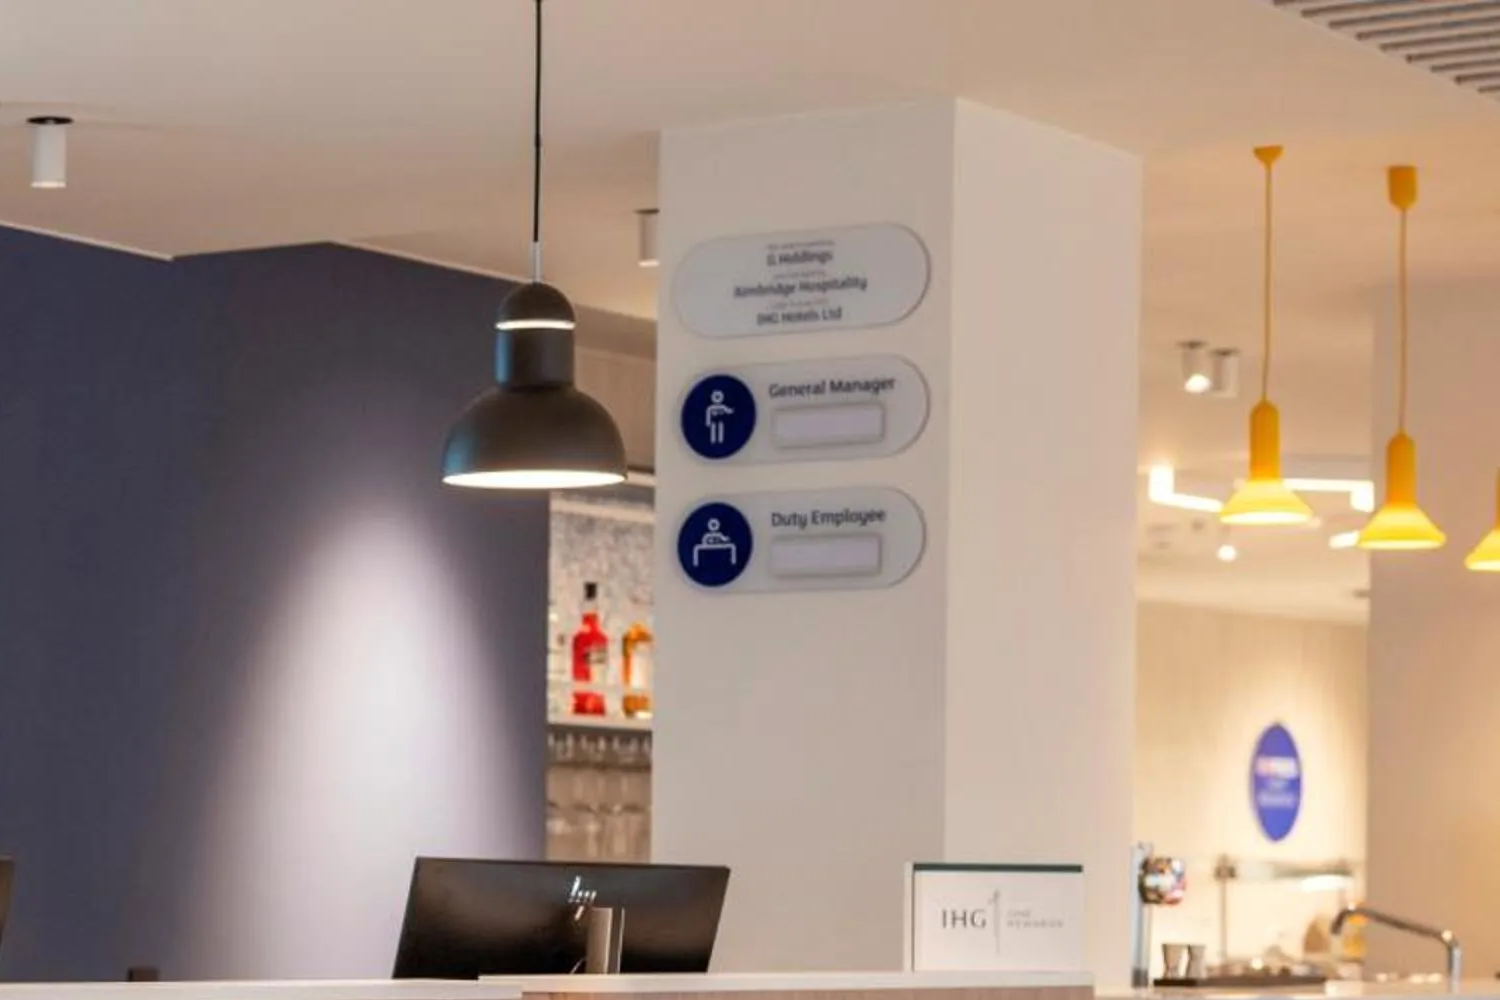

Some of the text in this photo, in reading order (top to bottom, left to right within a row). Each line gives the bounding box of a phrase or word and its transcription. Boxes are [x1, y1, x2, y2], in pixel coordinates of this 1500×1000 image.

[798, 276, 868, 294] Hospitality
[822, 306, 843, 321] Ltd
[768, 377, 896, 399] General Manager
[771, 508, 886, 529] Duty Employee
[941, 908, 987, 929] IHG
